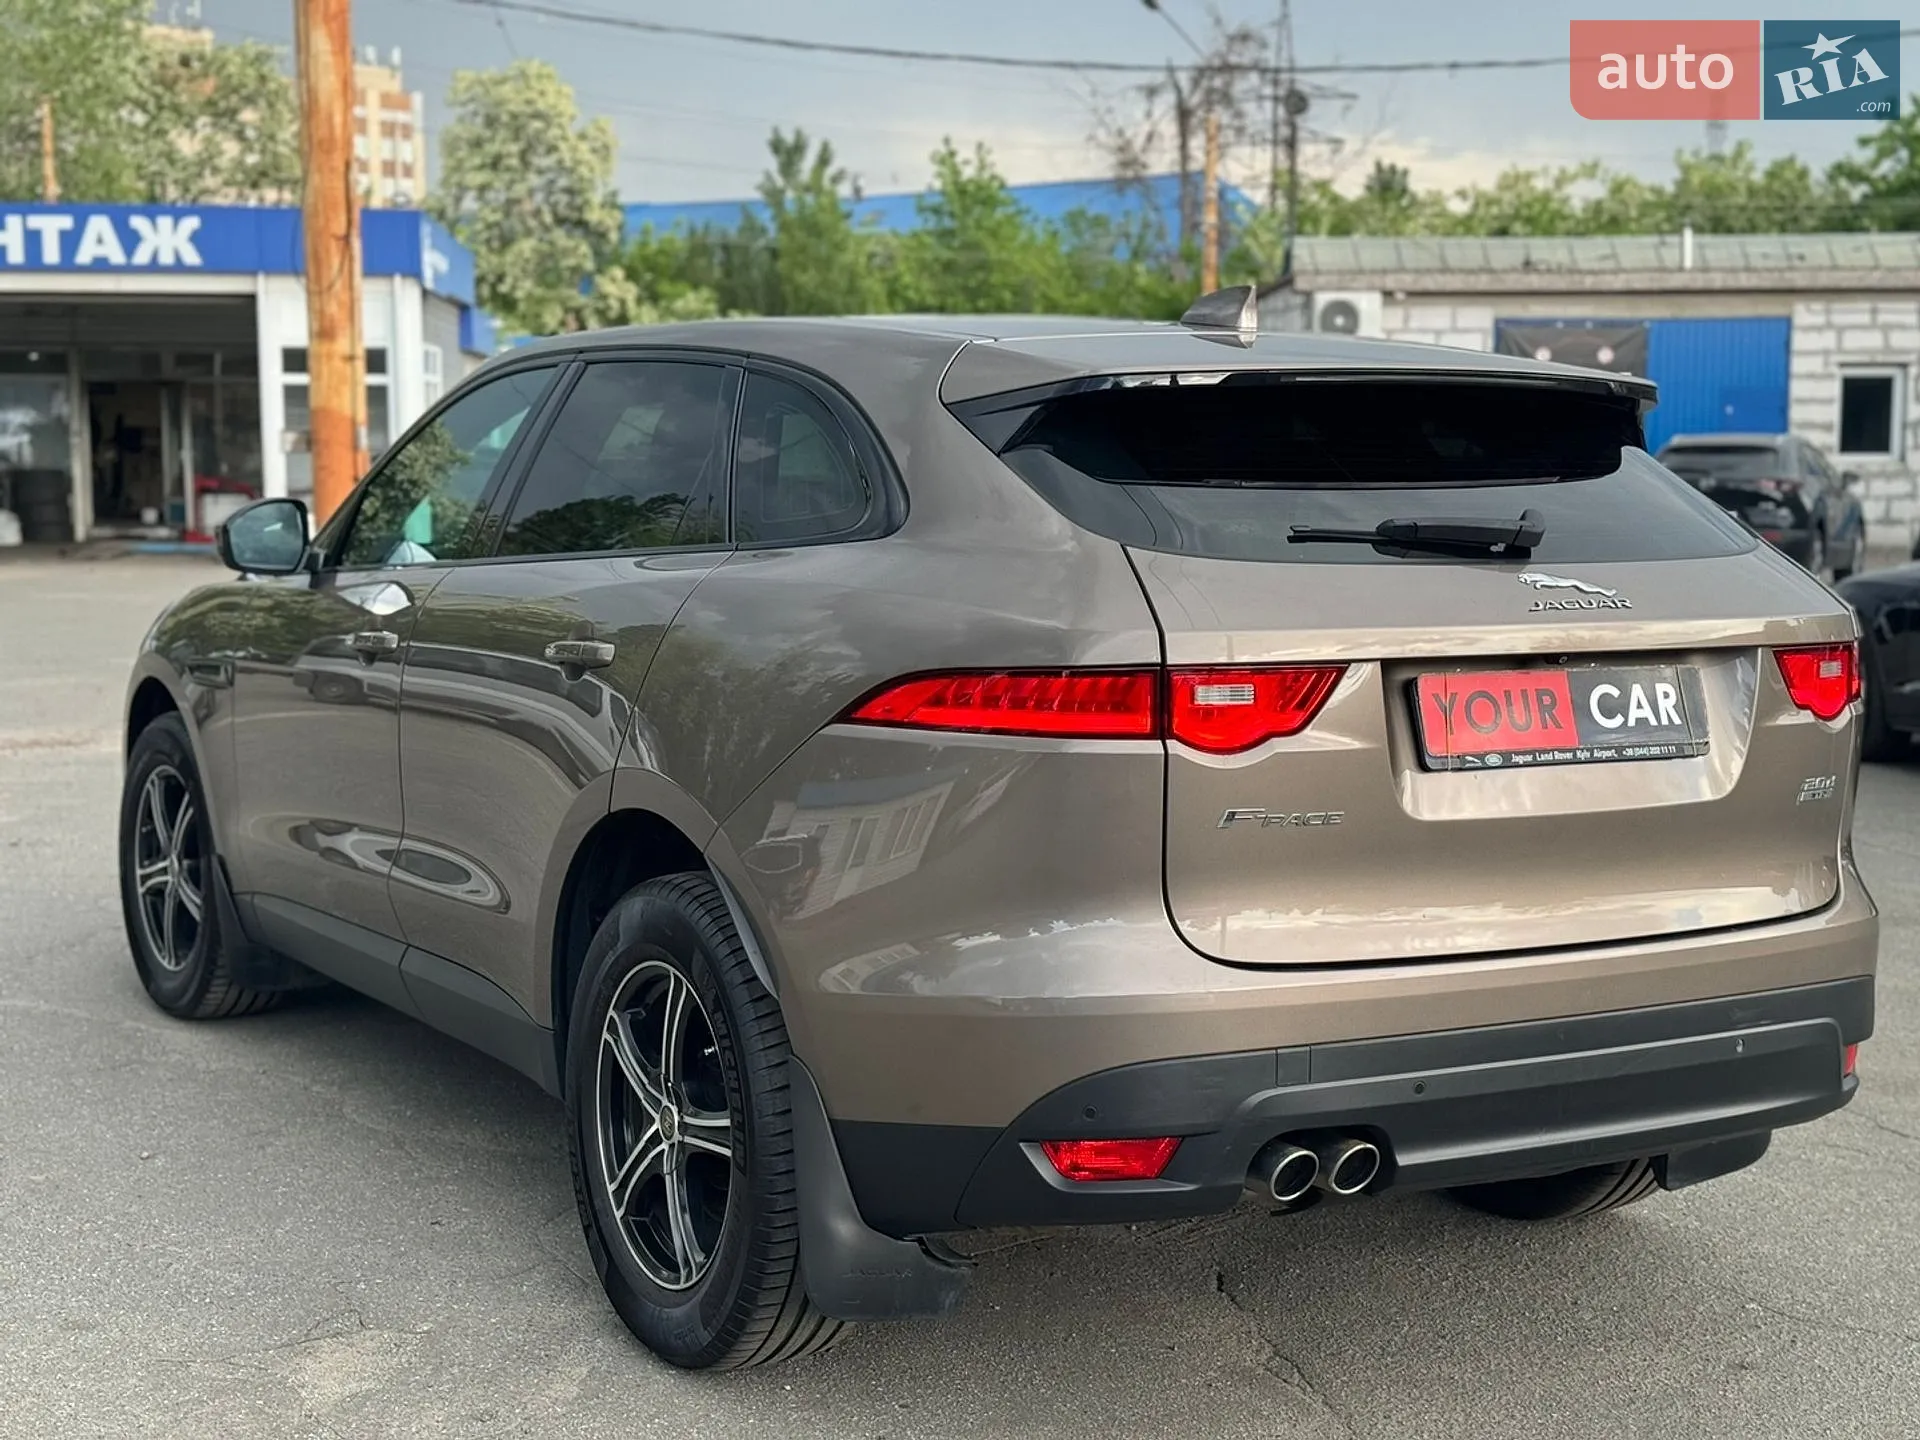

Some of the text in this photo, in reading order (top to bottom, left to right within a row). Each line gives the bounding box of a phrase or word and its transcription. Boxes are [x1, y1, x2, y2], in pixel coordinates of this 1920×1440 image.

[1529, 598, 1632, 611] JAGUAR
[1432, 683, 1682, 735] YOUR CAR
[1511, 753, 1533, 764] Jaguar
[1536, 751, 1553, 761] Land
[1554, 750, 1573, 760] Rover
